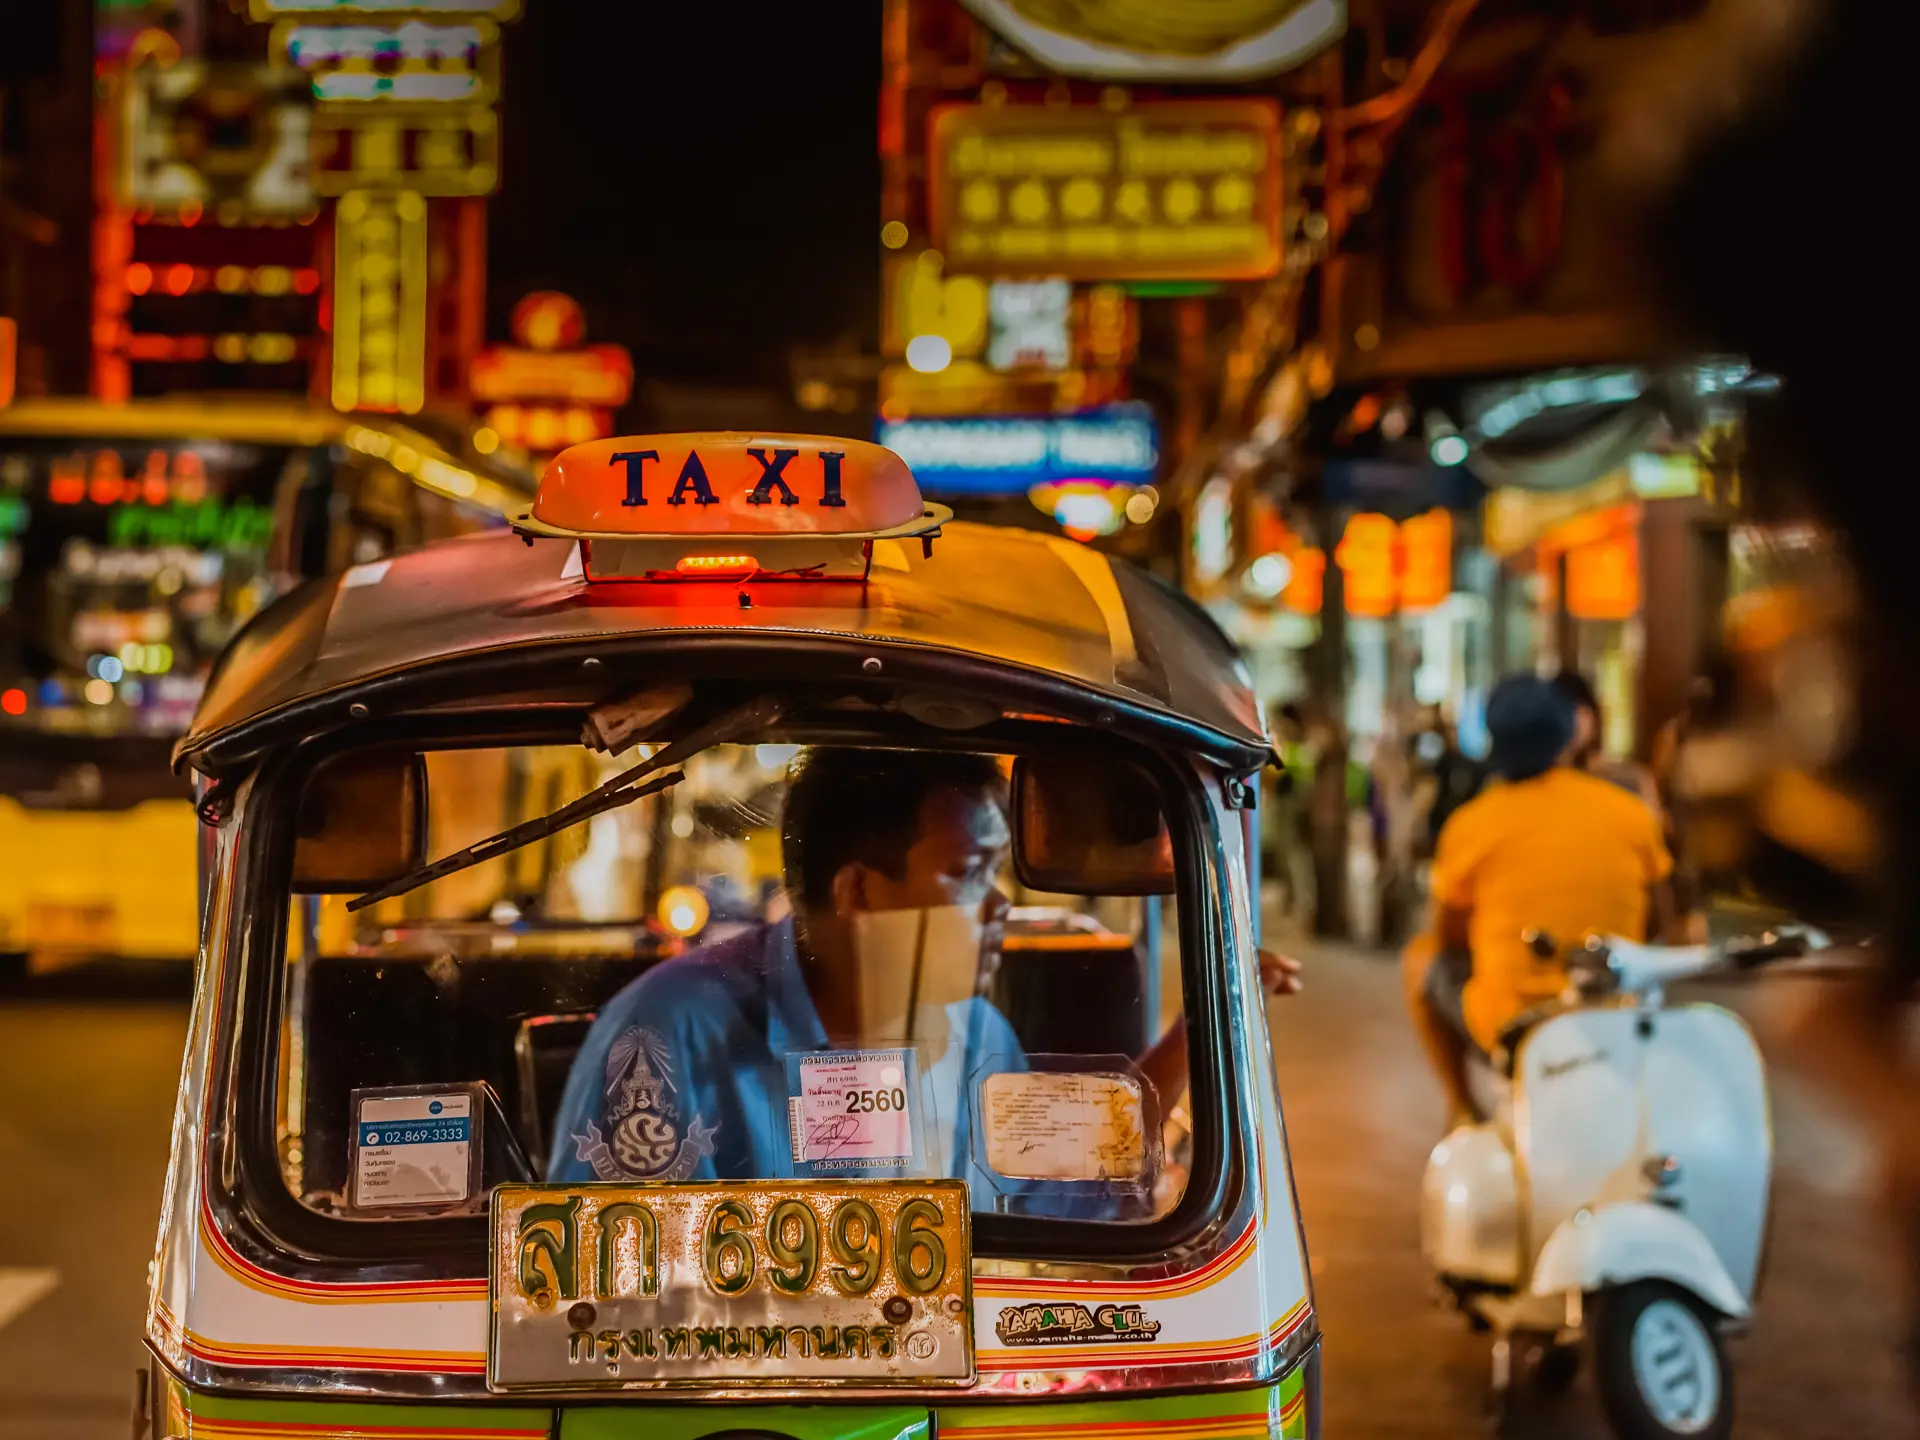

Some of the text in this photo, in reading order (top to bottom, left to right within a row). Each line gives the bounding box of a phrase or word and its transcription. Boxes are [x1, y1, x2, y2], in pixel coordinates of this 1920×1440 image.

[609, 447, 846, 507] TAXI
[800, 1052, 903, 1065] กรมการขนส่งทางบก
[845, 1088, 905, 1113] 2560
[384, 1127, 463, 1144] 02-869-3333
[812, 1159, 909, 1171] กระทรวงคมนาคม
[518, 1196, 948, 1301] สก 6996
[998, 1306, 1096, 1335] YAMAHA
[568, 1325, 898, 1376] กรุงเทพมหานคร
[1005, 1332, 1153, 1344] www.yamaha-mr.co.th
